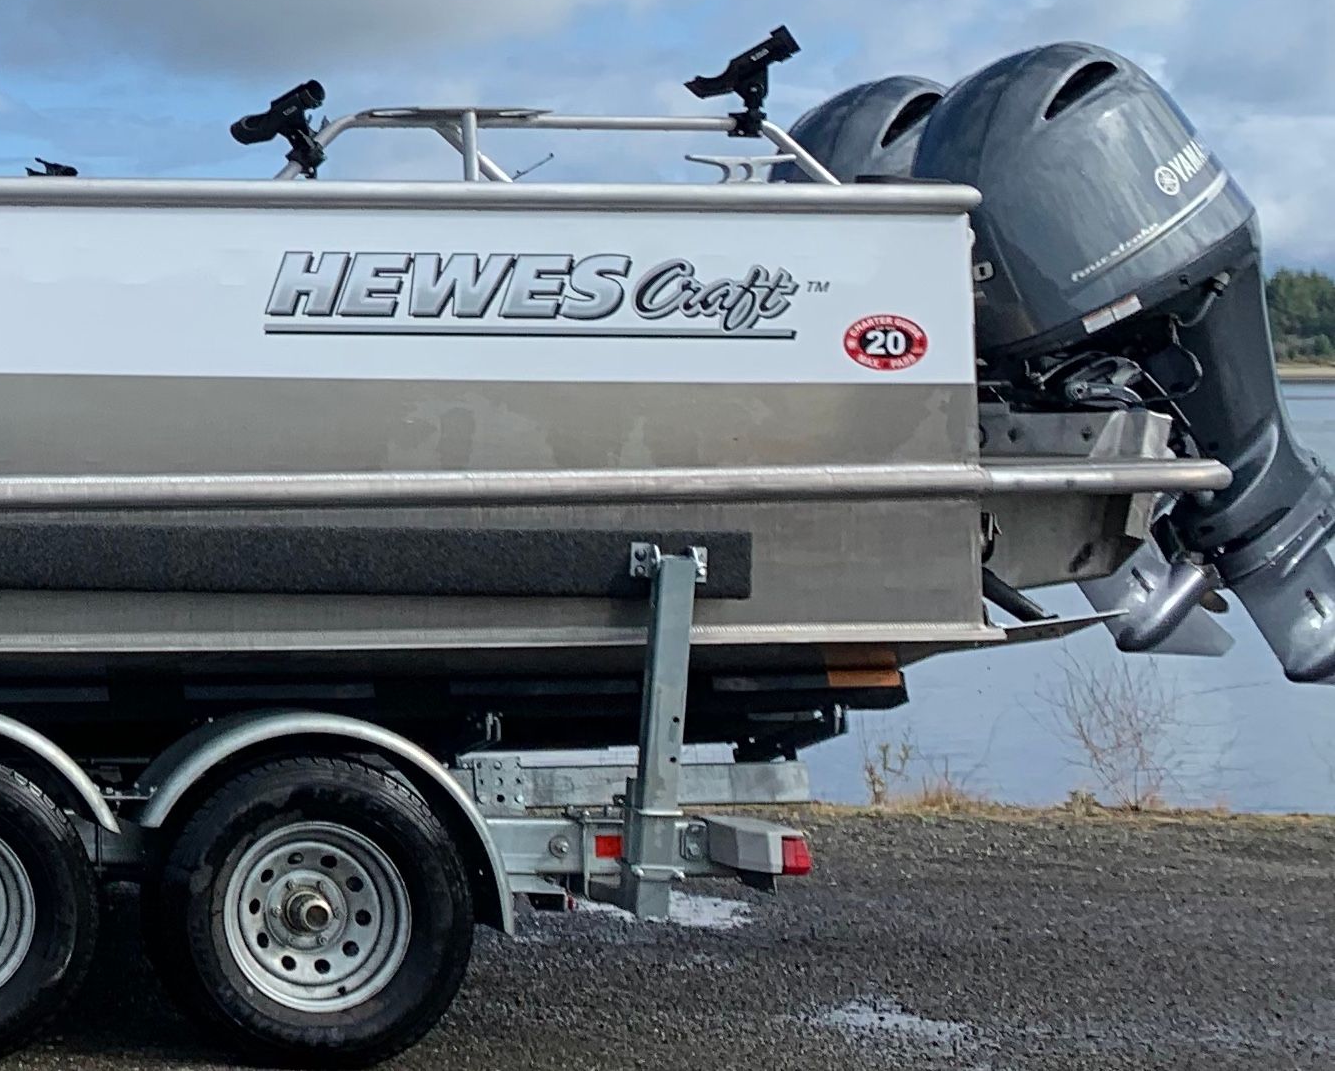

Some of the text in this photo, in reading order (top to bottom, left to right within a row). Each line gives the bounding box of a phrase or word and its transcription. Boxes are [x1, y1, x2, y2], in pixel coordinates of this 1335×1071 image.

[264, 250, 633, 321] HEWES
[632, 257, 799, 331] Craft
[865, 329, 907, 356] 20
